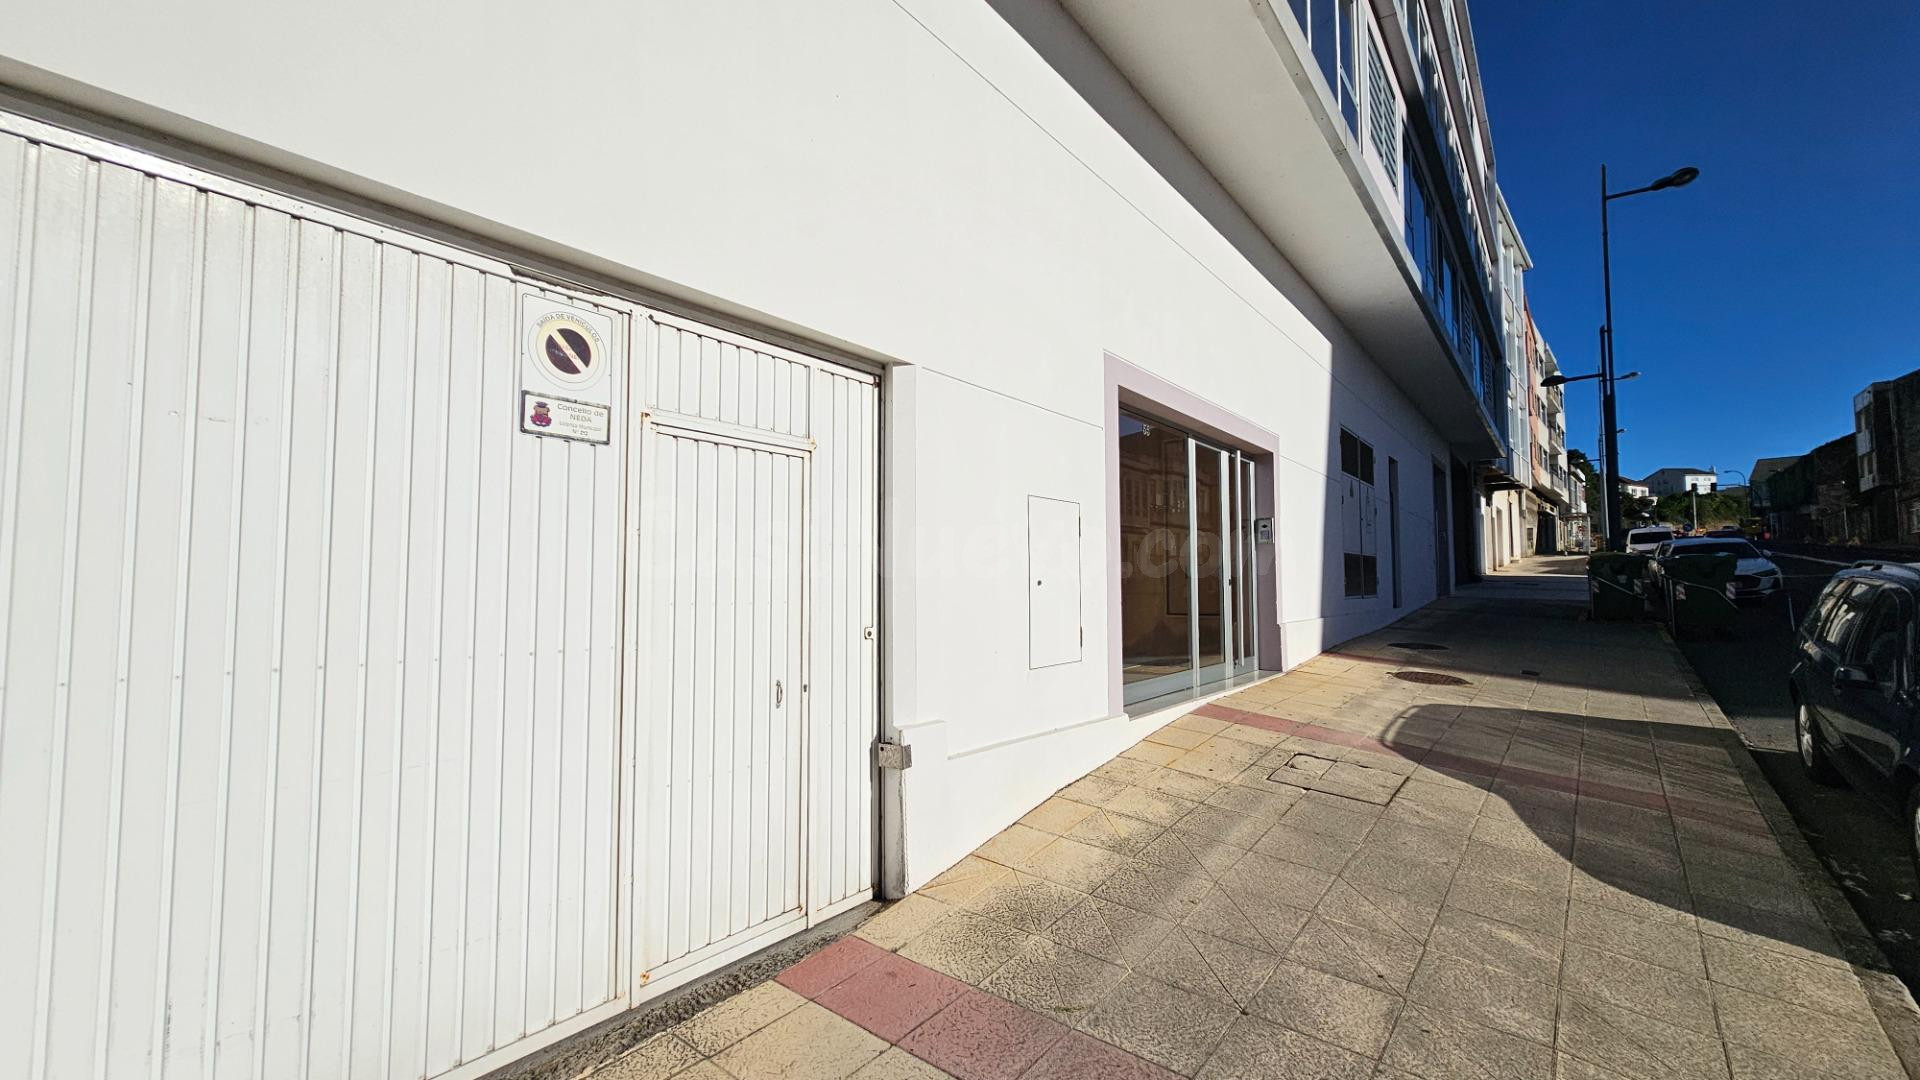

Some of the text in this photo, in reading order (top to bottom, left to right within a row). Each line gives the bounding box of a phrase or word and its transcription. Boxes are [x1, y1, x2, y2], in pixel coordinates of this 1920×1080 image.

[557, 403, 604, 418] Concello de
[569, 414, 592, 423] NEDA
